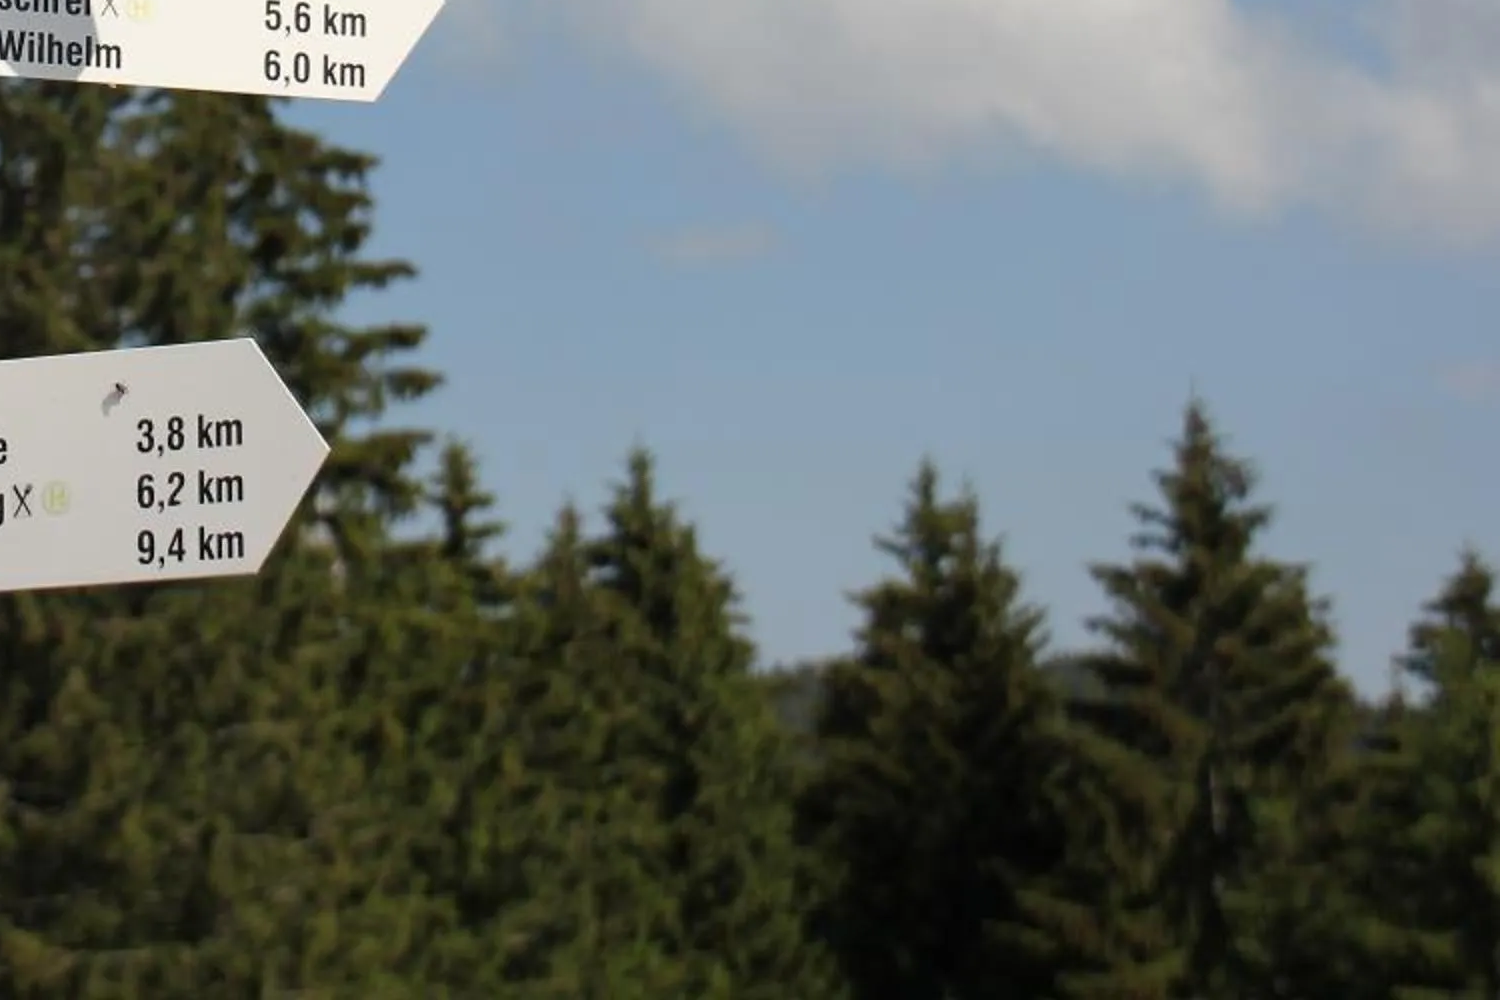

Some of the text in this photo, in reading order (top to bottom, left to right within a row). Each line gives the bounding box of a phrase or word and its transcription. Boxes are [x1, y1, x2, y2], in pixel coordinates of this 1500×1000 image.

[264, 0, 311, 35] 5,6
[323, 3, 367, 38] km
[264, 49, 311, 86] 6,0
[323, 54, 365, 89] km
[136, 415, 185, 457] 3,8
[197, 413, 243, 449] km
[137, 471, 186, 513] 6,2
[198, 469, 244, 505] km
[137, 527, 187, 569] 9,4
[198, 525, 245, 561] km
